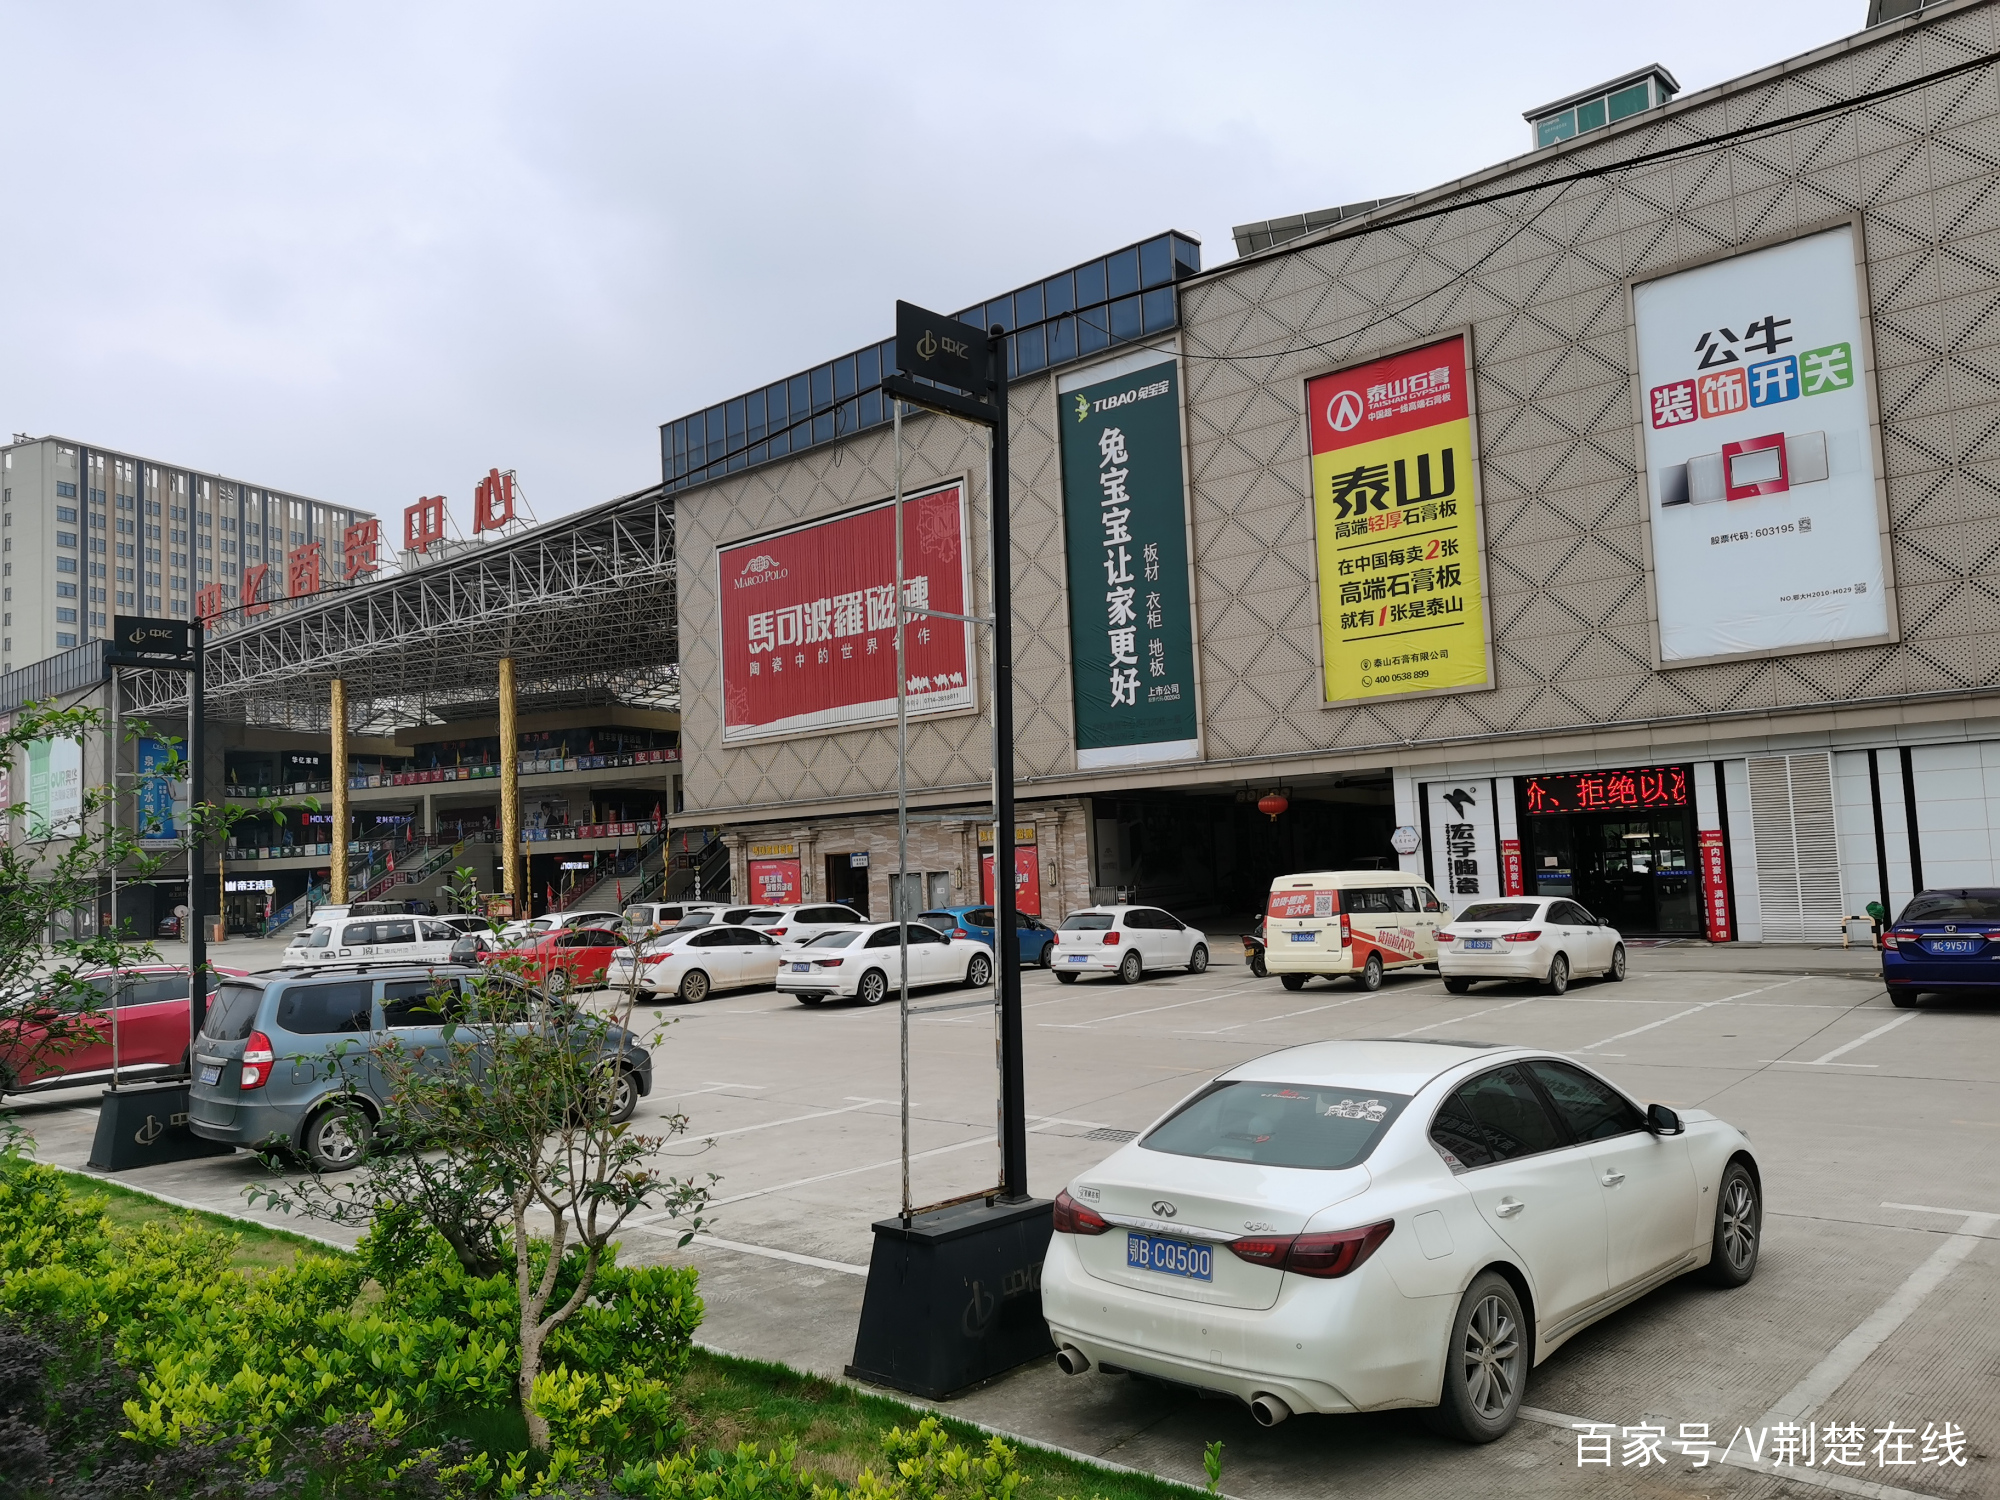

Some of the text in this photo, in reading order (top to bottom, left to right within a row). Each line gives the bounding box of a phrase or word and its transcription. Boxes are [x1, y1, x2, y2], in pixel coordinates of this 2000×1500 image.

[942, 336, 969, 359] 中亿
[1694, 315, 1793, 370] 公牛
[1138, 380, 1169, 400] 兔宝宝
[1366, 366, 1449, 403] 泰山石膏
[1368, 383, 1450, 410] TAISHAN GYPSUM
[1654, 347, 1849, 427] 装饰开关
[1332, 447, 1456, 521] 泰山
[1334, 499, 1458, 540] 高端轻厚石膏板
[195, 468, 514, 630] 中亿商贸中心
[1098, 427, 1141, 707] 兔宝宝让家更好
[1337, 538, 1459, 576] 在中国每卖2张
[734, 568, 788, 590] MARCO POLO
[1339, 563, 1462, 606] 高端石膏板
[1143, 542, 1166, 678] 板材 衣柜 地板
[1340, 595, 1463, 630] 就有1张是泰山
[149, 629, 173, 639] 中亿
[1373, 649, 1449, 668] 泰山石膏有限公司
[1374, 669, 1429, 684] 400 0538 899
[1148, 683, 1180, 697] 上市公司
[1450, 823, 1480, 894] 宏宇陶瓷
[1243, 1219, 1278, 1232] Q50L
